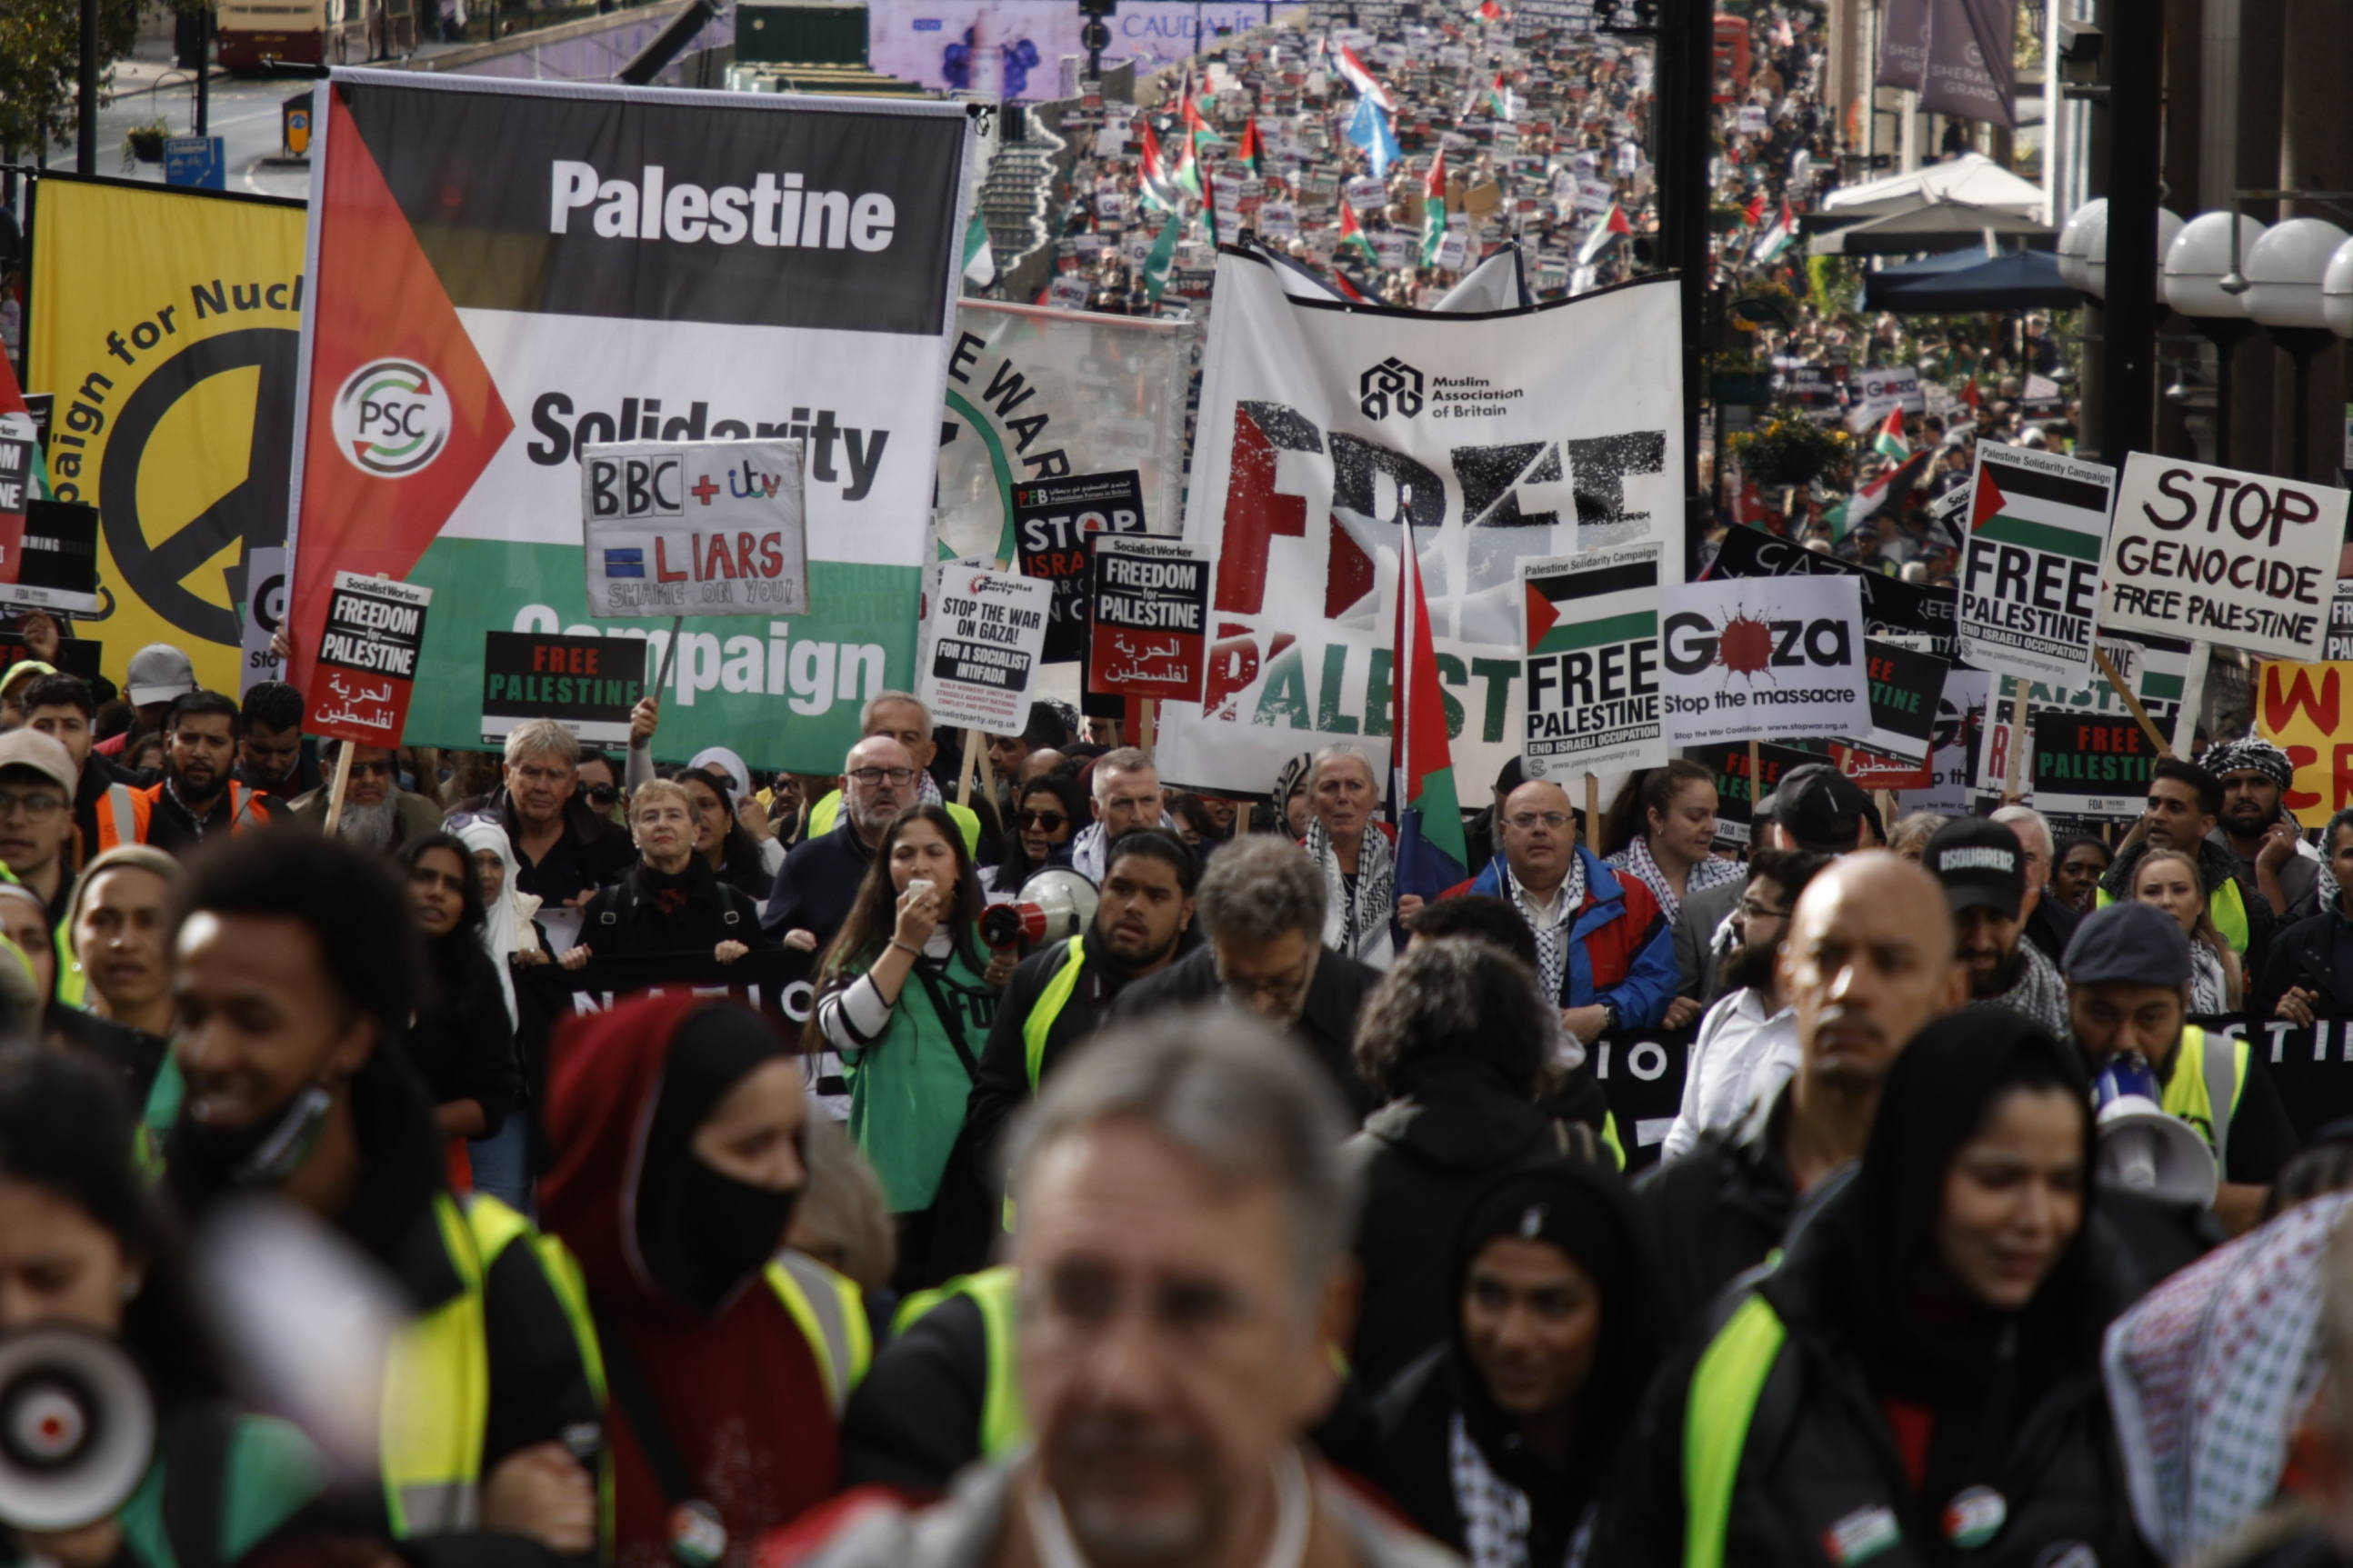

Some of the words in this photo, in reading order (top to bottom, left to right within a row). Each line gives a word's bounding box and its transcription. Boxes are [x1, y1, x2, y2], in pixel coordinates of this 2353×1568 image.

[550, 160, 895, 252] Palestine
[191, 275, 305, 320] Nucl
[1052, 284, 1085, 302] Gza
[106, 304, 178, 365] for
[1431, 386, 1524, 403] Association
[1432, 376, 1490, 388] Muslim
[1867, 376, 1917, 398] Gza
[358, 401, 426, 438] PSC
[1432, 405, 1450, 419] of
[1453, 404, 1507, 418] Britain
[1980, 446, 2022, 466] Palestine
[2024, 455, 2066, 476] Solidarity
[2068, 465, 2111, 484] Campaign
[591, 461, 680, 515] BBC
[728, 460, 781, 498] itv
[1018, 489, 1048, 506] PFB
[2143, 468, 2319, 547] STOP
[656, 532, 784, 584] LIARS
[1114, 540, 1156, 555] Socialist
[1156, 547, 1194, 557] Worker
[1525, 561, 1569, 576] Palestine
[1571, 554, 1611, 570] Solidarity
[1613, 548, 1658, 564] Campaign
[1106, 558, 1197, 591] FREEDOM
[1964, 537, 2099, 619] FREE
[2116, 535, 2323, 604] GENOCIDE
[346, 577, 388, 595] Socialist
[387, 585, 421, 602] Worker
[607, 583, 685, 608] SHAME
[702, 583, 733, 604] ON
[746, 580, 793, 604] YOU!
[984, 576, 1033, 593] Socialist
[1143, 587, 1158, 601] for
[334, 594, 419, 635] FREEDOM
[943, 597, 977, 618] STOP
[981, 603, 1006, 623] THE
[1009, 608, 1041, 630] WAR
[1099, 594, 1200, 629] PALESTINE
[1962, 593, 2092, 646] PALESTINE
[2113, 583, 2182, 620] FREE
[2187, 595, 2319, 645] PALESTINE
[366, 628, 382, 642] for
[957, 619, 976, 637] ON
[979, 623, 1019, 645] GAZA!
[1961, 622, 1981, 636] END
[1982, 626, 2023, 647] ISRAELI
[2024, 639, 2088, 664] OCCUPATION
[321, 634, 415, 674] PALESTINE
[533, 645, 599, 674] FREE
[938, 641, 961, 659] FOR
[962, 644, 970, 660] A
[973, 646, 1029, 671] SOCIALIST
[1114, 633, 1180, 662] الحرية
[1977, 646, 2066, 674] www.palestinecampaign.org
[956, 663, 1007, 684] INTIFADA
[1105, 659, 1188, 684] لفلسطين
[1527, 639, 1659, 713] FREE
[328, 673, 392, 703] الحرية
[489, 674, 639, 706] PALESTINE
[936, 689, 965, 700] STRUGGLE
[966, 693, 990, 704] AGAINST
[990, 697, 1017, 708] NATIONAL
[939, 682, 956, 690] BUILD
[986, 688, 1004, 697] UNITY
[1005, 692, 1016, 700] AND
[1665, 694, 1710, 715] Stop
[1715, 691, 1747, 709] the
[1753, 688, 1856, 706] massacre
[315, 701, 395, 729] لفلسطين
[937, 698, 965, 708] CONFLICT
[978, 704, 1014, 715] OPPRESSION
[1527, 694, 1659, 739] PALESTINE
[1529, 741, 1553, 755] END
[1556, 735, 1595, 753] ISRAELI
[1597, 724, 1659, 746] OCCUPATION
[1674, 732, 1693, 740] Stop
[1709, 728, 1724, 736] War
[1726, 725, 1763, 734] Coalition
[1767, 723, 1848, 731] www.stopwar.org.uk
[2078, 725, 2140, 753] FREE
[1552, 748, 1640, 770] www.palestinecampaign.org
[2039, 752, 2155, 782] PALESTI
[1940, 801, 1955, 809] War
[2088, 799, 2103, 810] FOA
[1720, 824, 1735, 836] FOA
